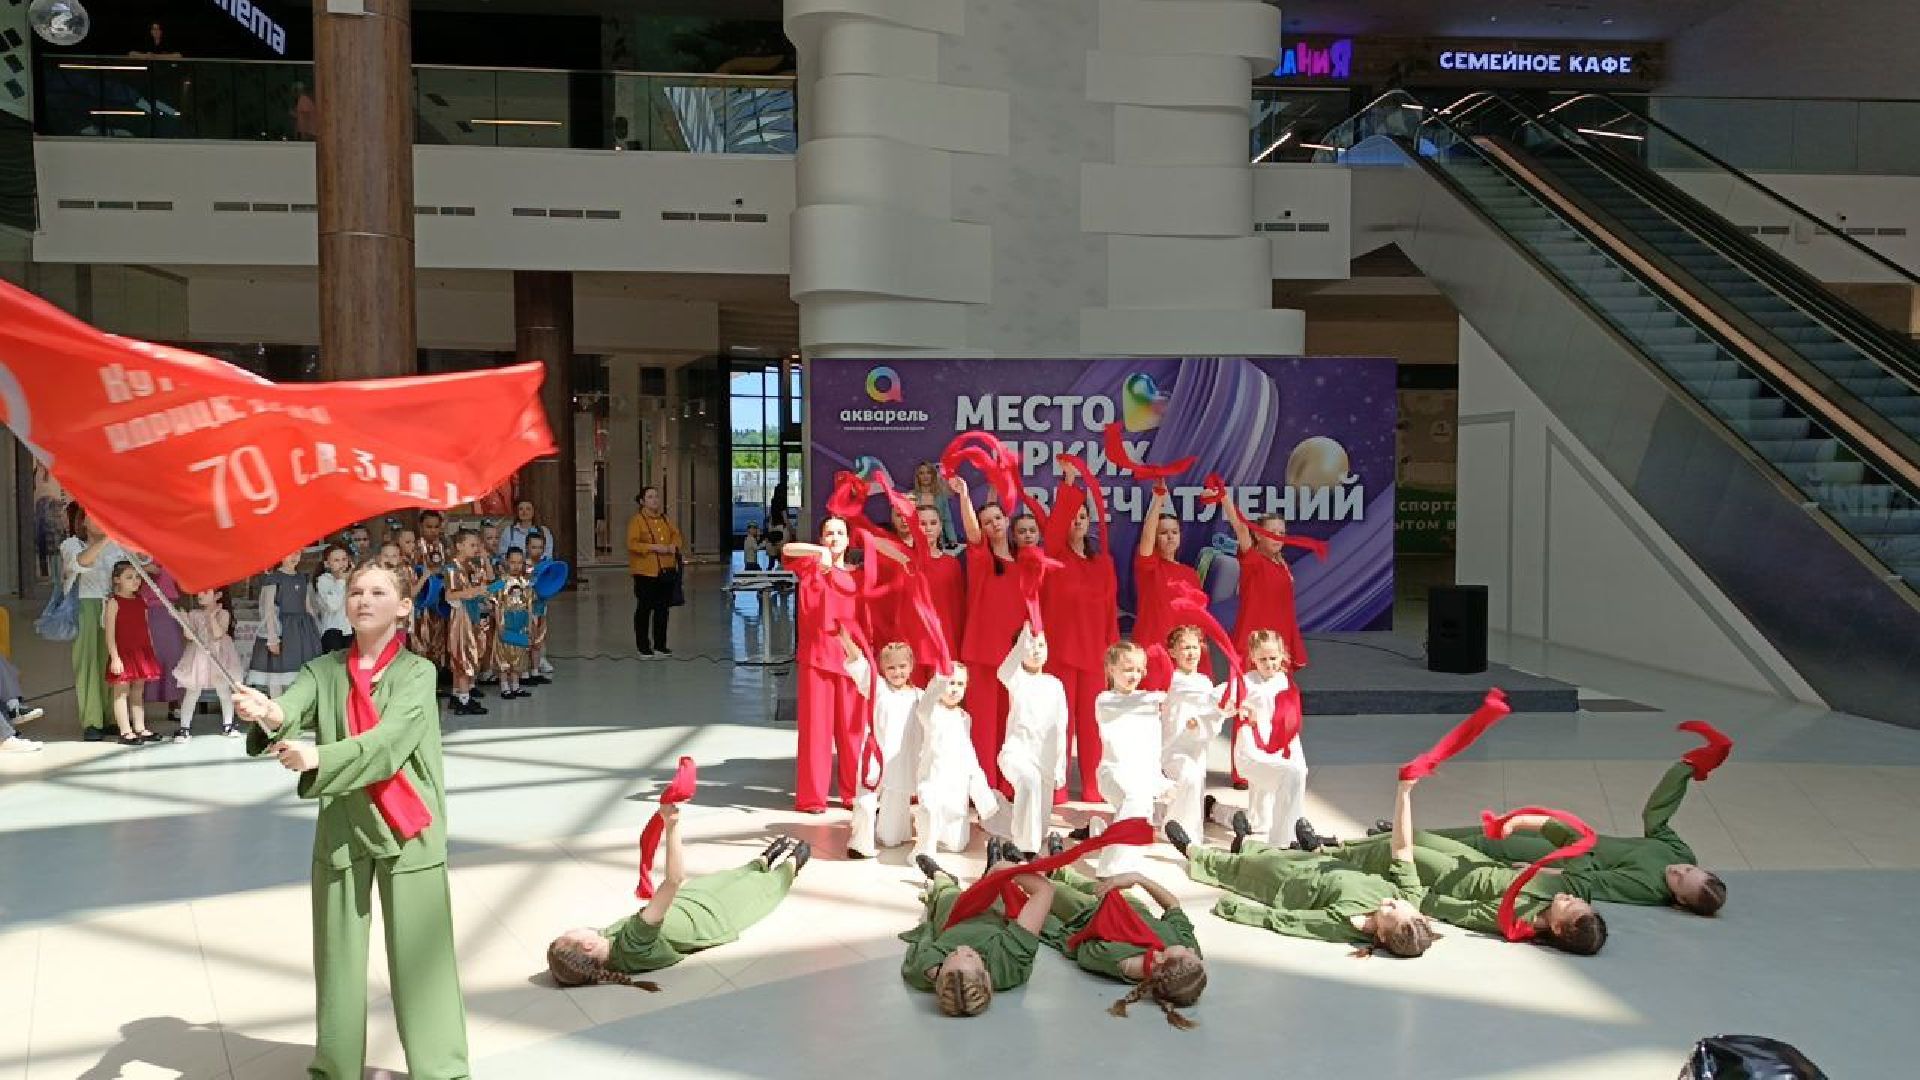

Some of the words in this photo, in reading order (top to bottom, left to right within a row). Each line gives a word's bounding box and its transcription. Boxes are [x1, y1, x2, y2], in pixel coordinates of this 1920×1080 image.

[214, 0, 286, 55] nema
[1274, 39, 1352, 78] АНИЯ
[1439, 50, 1561, 72] СЕМЕЙНОЕ
[1569, 56, 1632, 74] КАФЕ
[840, 410, 929, 425] акварель
[954, 395, 1115, 432] МЕСТО
[187, 445, 279, 529] 79
[1023, 474, 1364, 523] ВЕЧАТЛЕНИЙ
